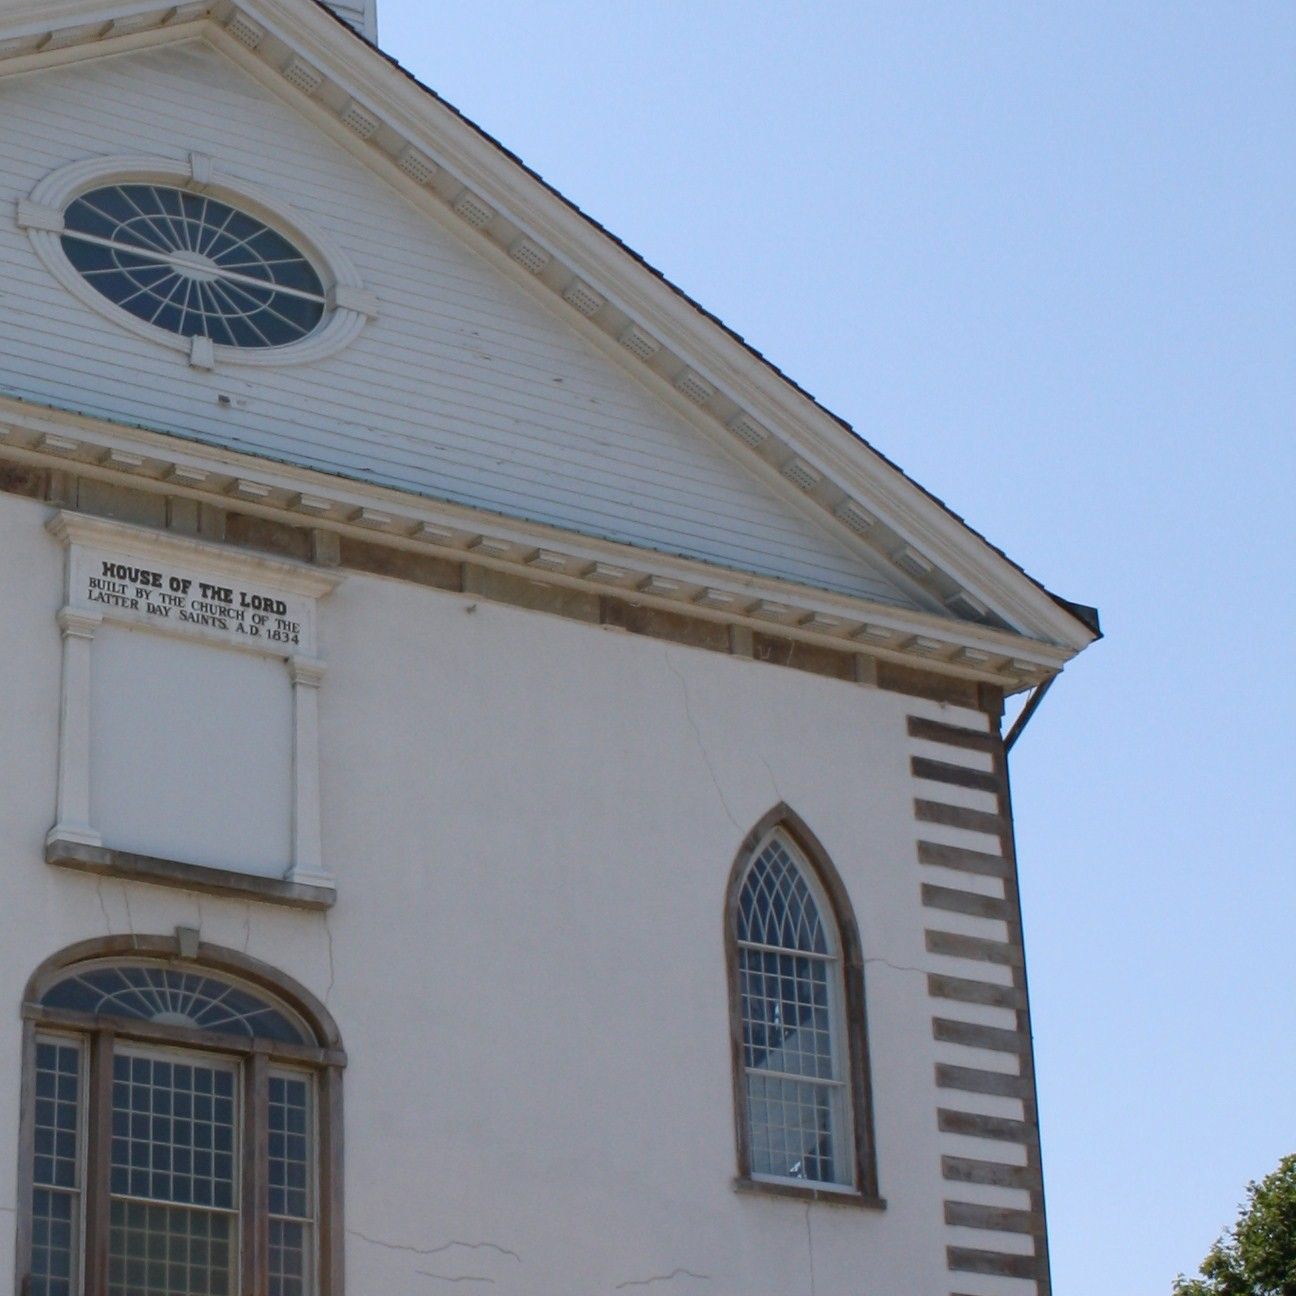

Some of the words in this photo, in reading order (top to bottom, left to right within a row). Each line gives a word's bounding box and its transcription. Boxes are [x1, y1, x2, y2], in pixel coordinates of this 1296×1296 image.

[89, 576, 128, 595] BUILT
[135, 587, 152, 600] BY
[159, 592, 186, 608] THE
[191, 600, 244, 621] CHURCH
[251, 613, 269, 626] OF
[275, 618, 301, 634] THE
[102, 561, 162, 589] HOUSE
[169, 576, 192, 594] OF
[199, 583, 233, 604] THE
[239, 592, 287, 616] LORD
[88, 589, 139, 610] LATTER
[146, 602, 171, 617] DAY
[266, 628, 300, 645] 1834
